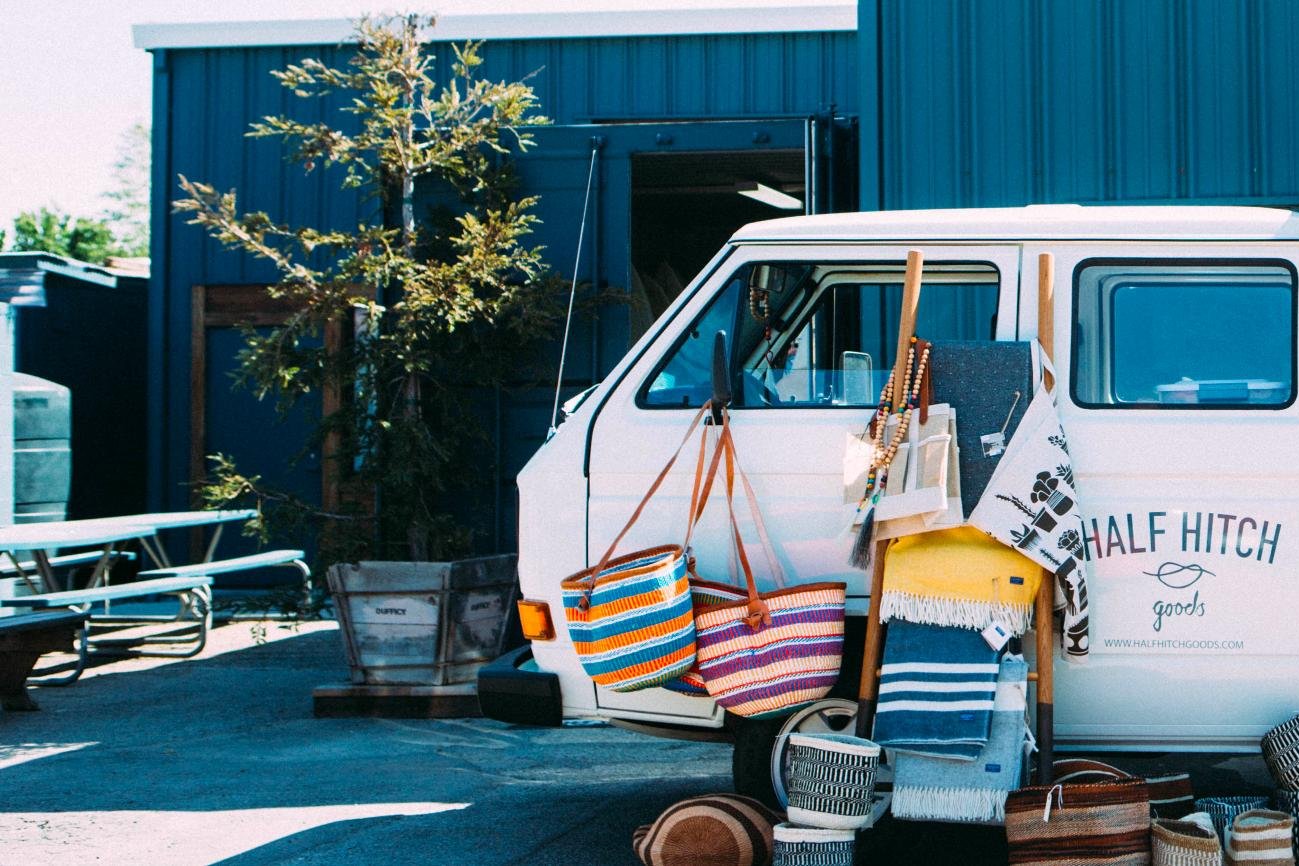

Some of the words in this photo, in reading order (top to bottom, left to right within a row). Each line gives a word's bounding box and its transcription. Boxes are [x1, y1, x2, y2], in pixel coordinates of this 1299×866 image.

[1081, 511, 1167, 562] HALF
[1181, 511, 1282, 564] HITCH
[1152, 590, 1206, 632] goods
[1104, 638, 1244, 650] WWW.HALFHITCHGOODS.COM
